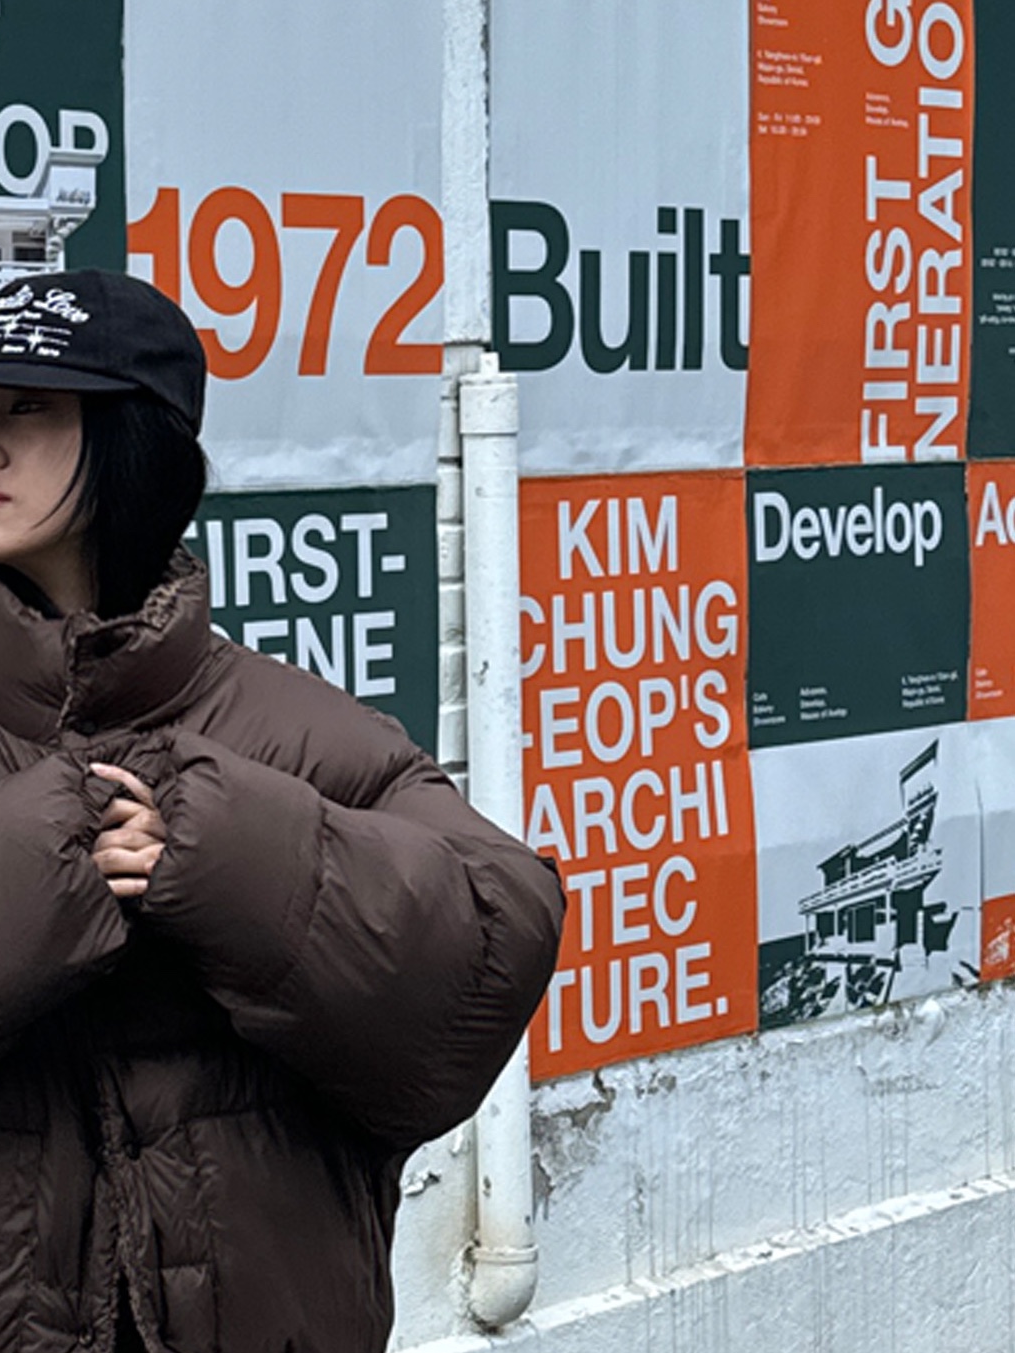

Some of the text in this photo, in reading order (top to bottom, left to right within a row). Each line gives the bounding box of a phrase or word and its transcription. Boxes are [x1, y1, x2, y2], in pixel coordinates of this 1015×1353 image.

[914, 2, 964, 462] NERATIO
[127, 186, 445, 381] 1972
[489, 199, 751, 374] Built
[861, 155, 913, 463] FIRST
[183, 512, 406, 609] IRST-
[557, 495, 679, 580] KIM
[753, 485, 943, 567] Develop
[975, 481, 1015, 547] A
[520, 580, 738, 679] CHUNG
[526, 760, 729, 861] ARCHI
[566, 855, 698, 952] TEC
[545, 941, 729, 1053] TURE.
